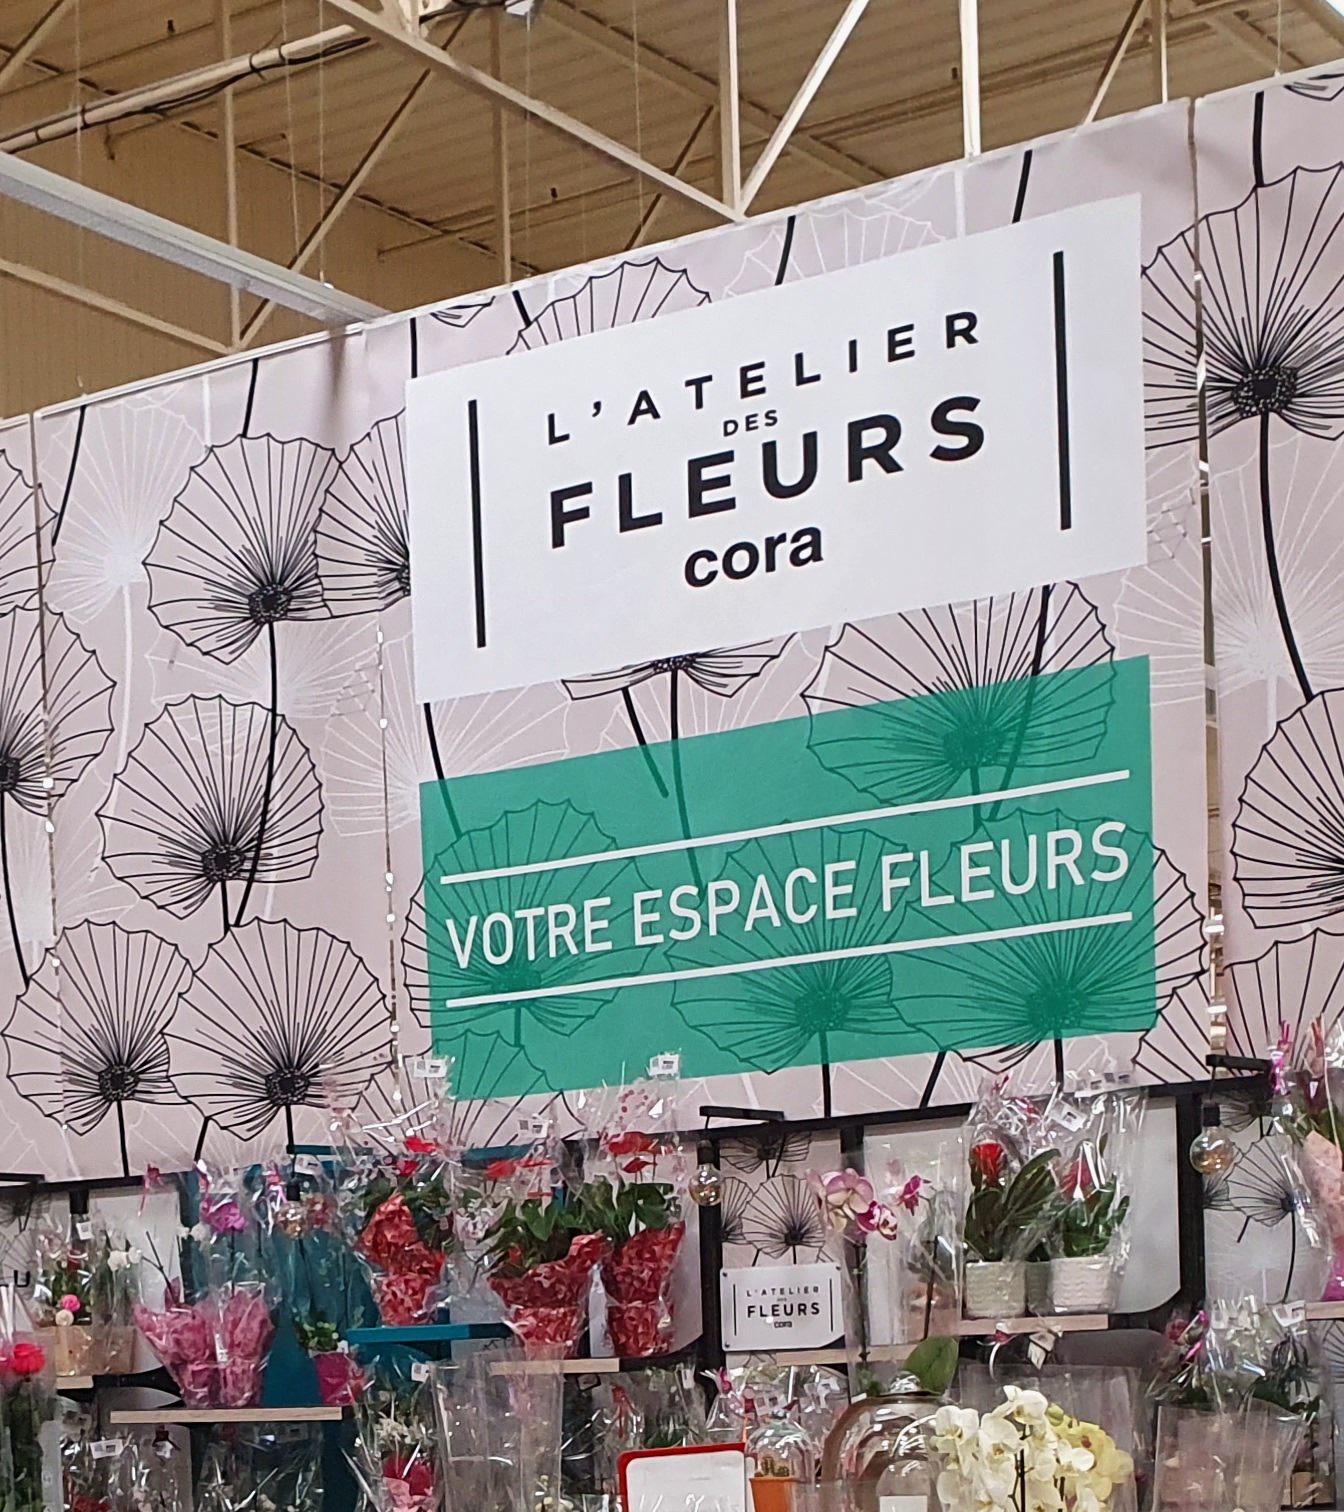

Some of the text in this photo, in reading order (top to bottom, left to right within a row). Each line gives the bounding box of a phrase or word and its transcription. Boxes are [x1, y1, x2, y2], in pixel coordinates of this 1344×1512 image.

[547, 310, 981, 446] L'ATELIER
[722, 408, 779, 437] DES
[549, 395, 986, 549] FLEURS
[683, 524, 824, 588] cora
[445, 820, 1131, 969] VOTRE ESPACE FLEURS
[747, 1302, 821, 1319] FLEURS
